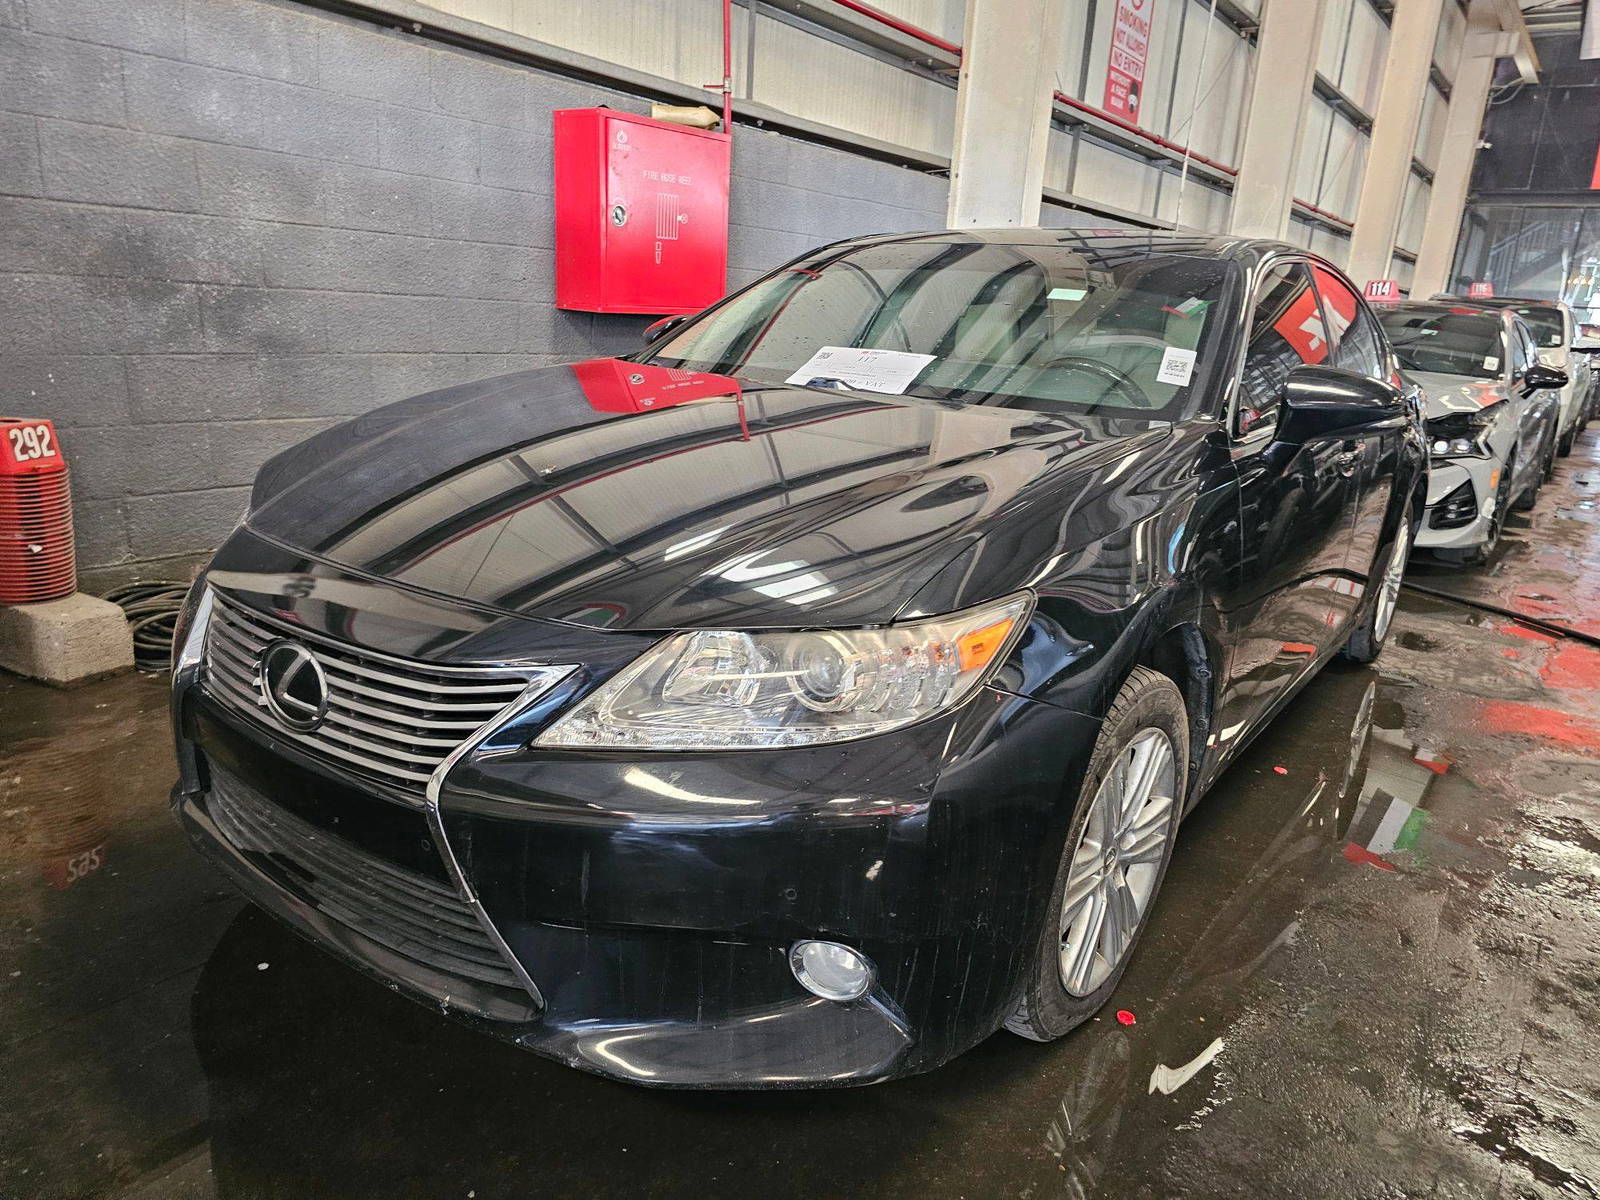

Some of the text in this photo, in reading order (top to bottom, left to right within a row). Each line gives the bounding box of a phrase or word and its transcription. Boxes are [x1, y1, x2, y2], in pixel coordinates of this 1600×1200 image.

[1119, 6, 1148, 38] SMOKING
[1115, 28, 1126, 46] NOT
[1113, 50, 1143, 79] NO ENTRY
[643, 169, 659, 181] FIRE
[1371, 281, 1392, 296] 114
[8, 424, 56, 463] 292
